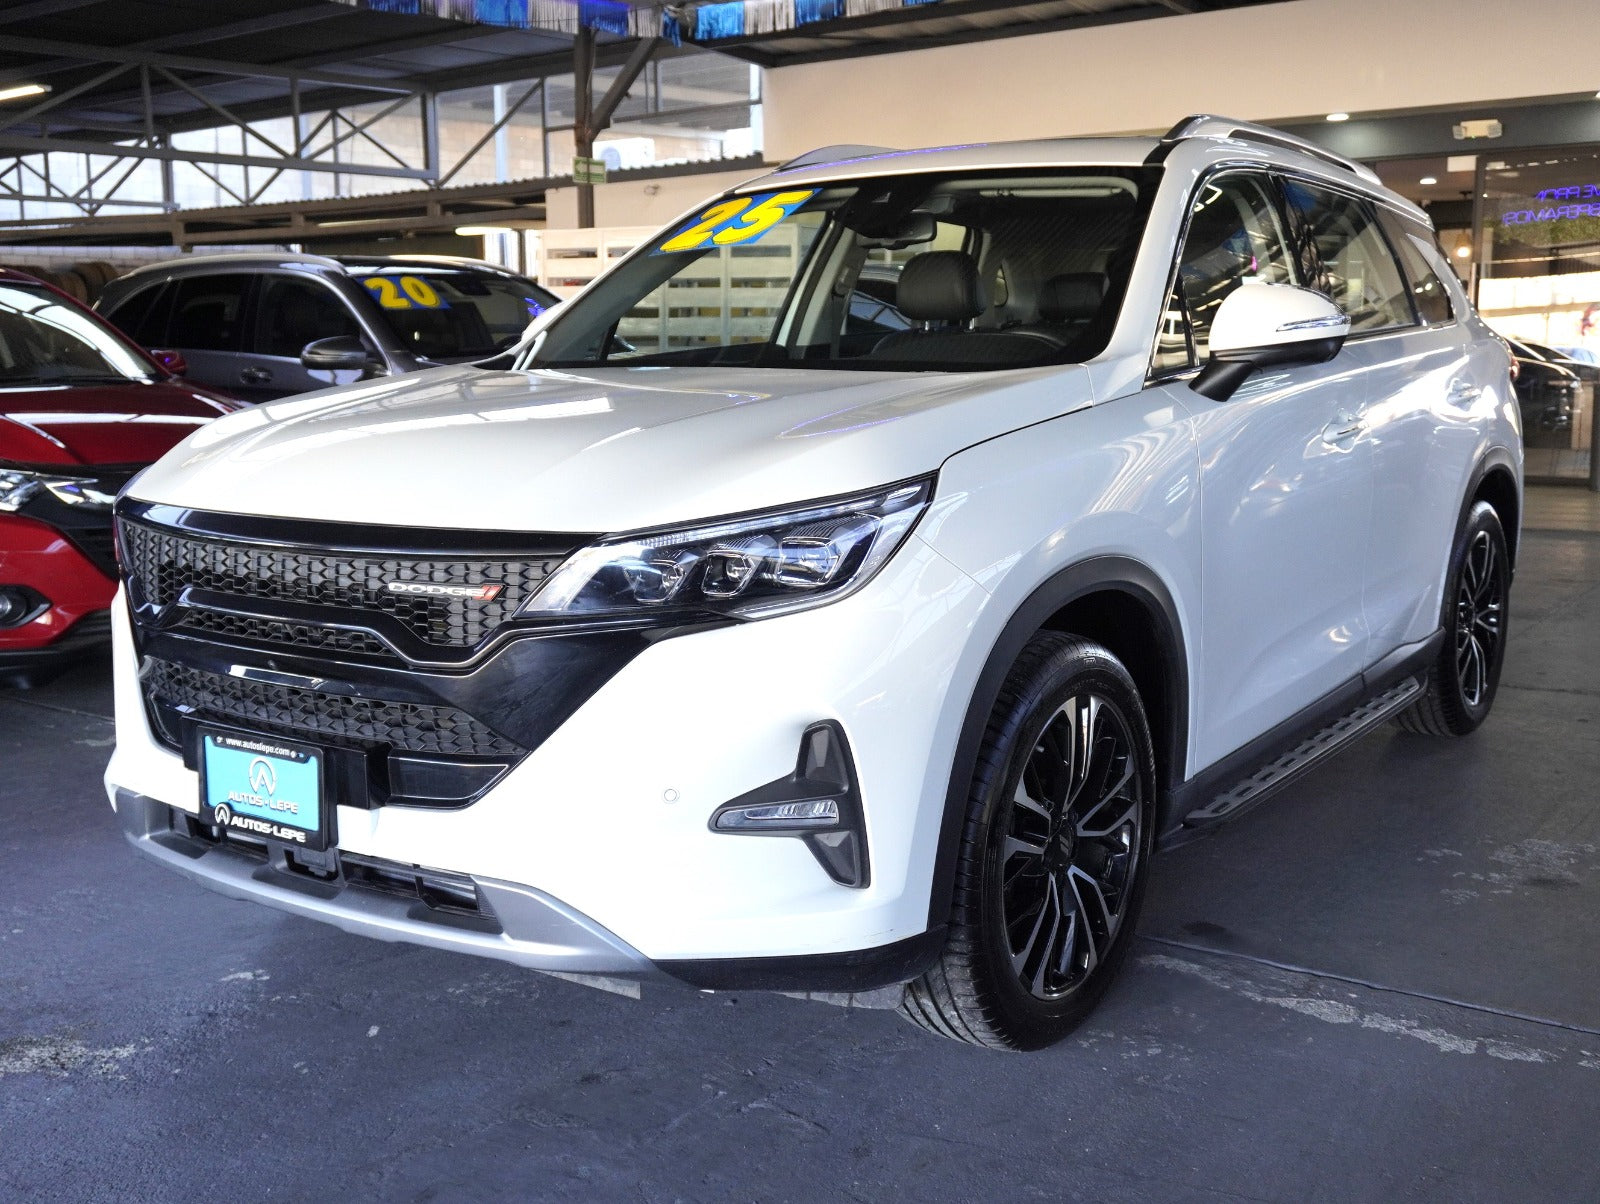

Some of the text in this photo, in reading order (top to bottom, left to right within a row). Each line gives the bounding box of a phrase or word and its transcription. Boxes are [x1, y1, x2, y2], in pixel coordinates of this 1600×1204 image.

[660, 190, 813, 252] 25
[363, 276, 440, 310] 20
[388, 582, 485, 597] DODGE
[225, 737, 290, 756] www.autoslepe.com
